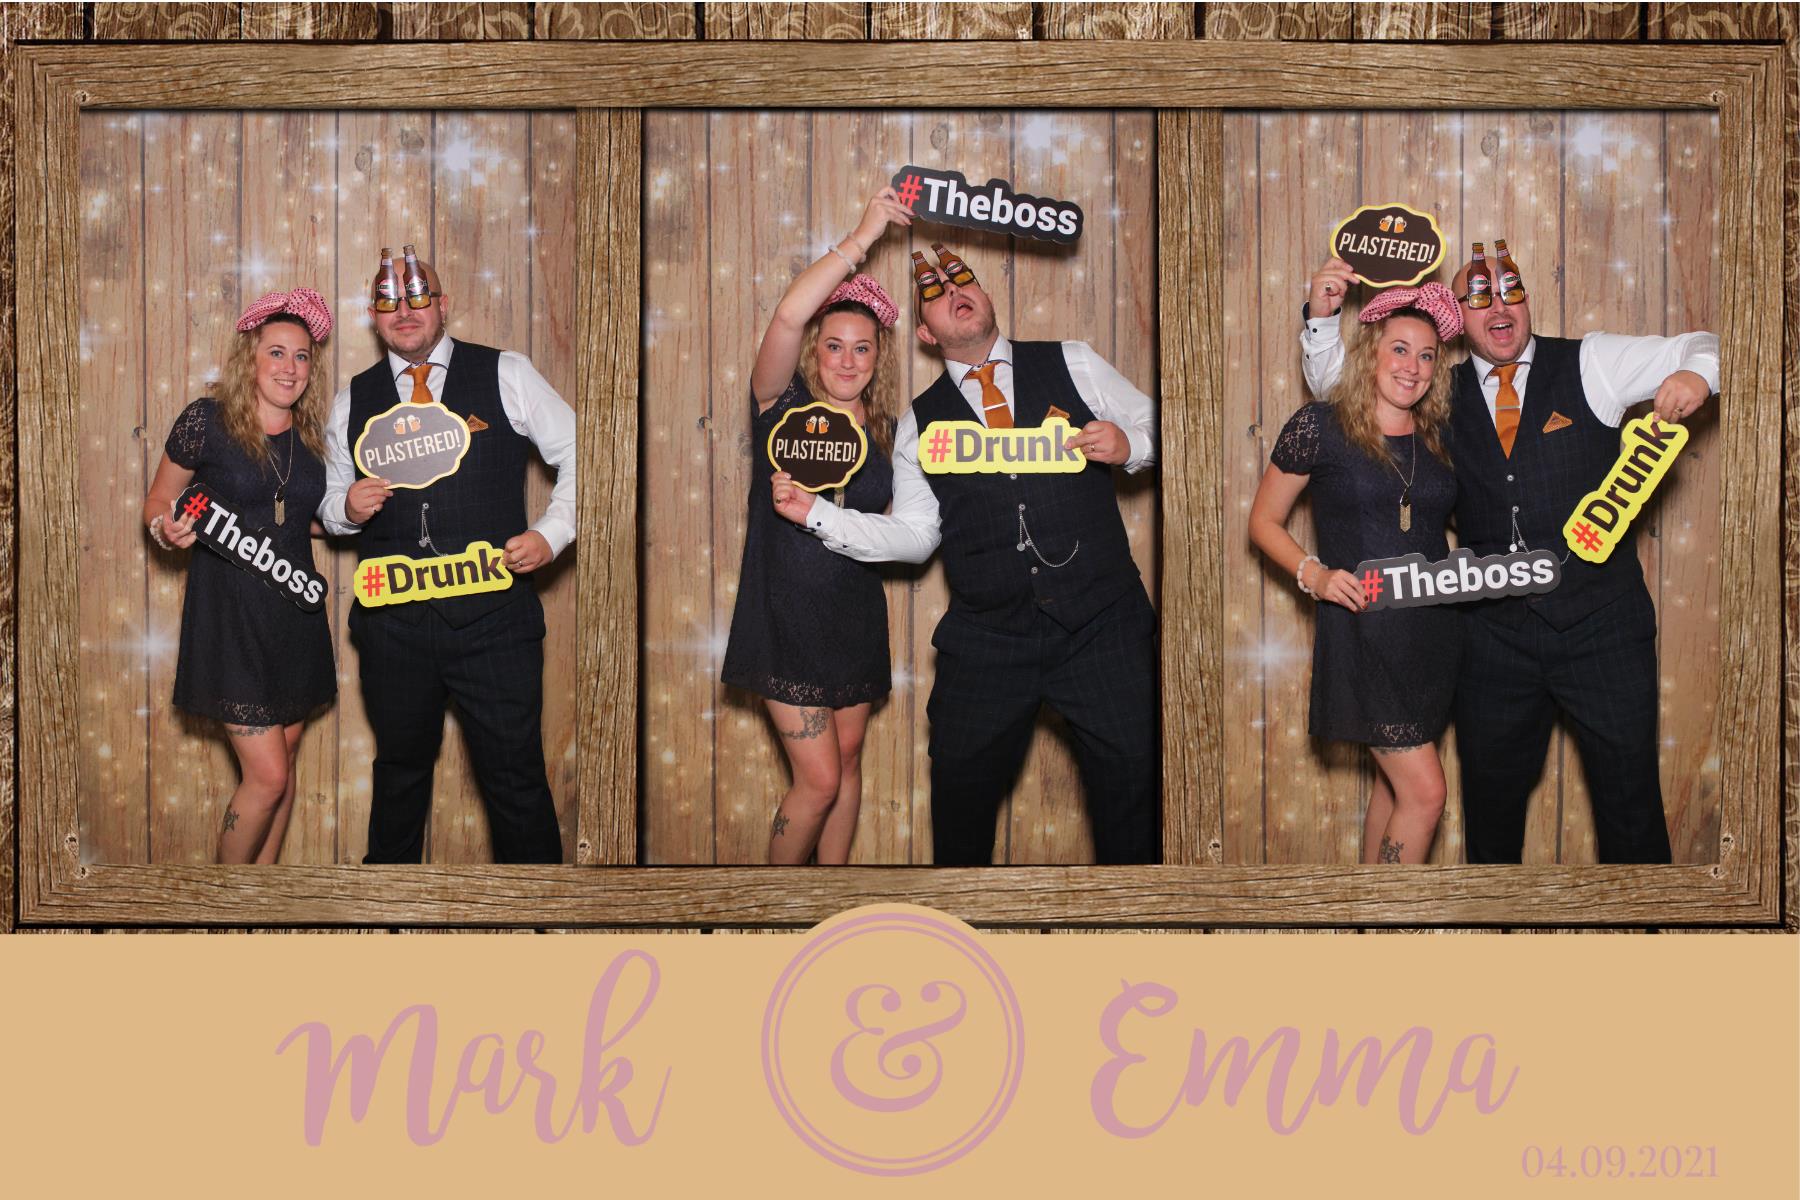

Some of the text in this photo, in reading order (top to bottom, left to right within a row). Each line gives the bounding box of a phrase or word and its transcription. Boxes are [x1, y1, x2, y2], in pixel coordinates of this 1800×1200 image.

[898, 174, 1078, 235] #Theboss
[1339, 233, 1435, 263] PLASTERED!
[366, 429, 462, 467] PLASTERED!
[775, 438, 857, 463] PLASTERED!
[927, 425, 1079, 463] #Drunk
[1571, 421, 1678, 552] #Drunk
[184, 492, 323, 604] #Theboss
[362, 549, 505, 597] #Drunk
[1360, 557, 1554, 602] #Theboss
